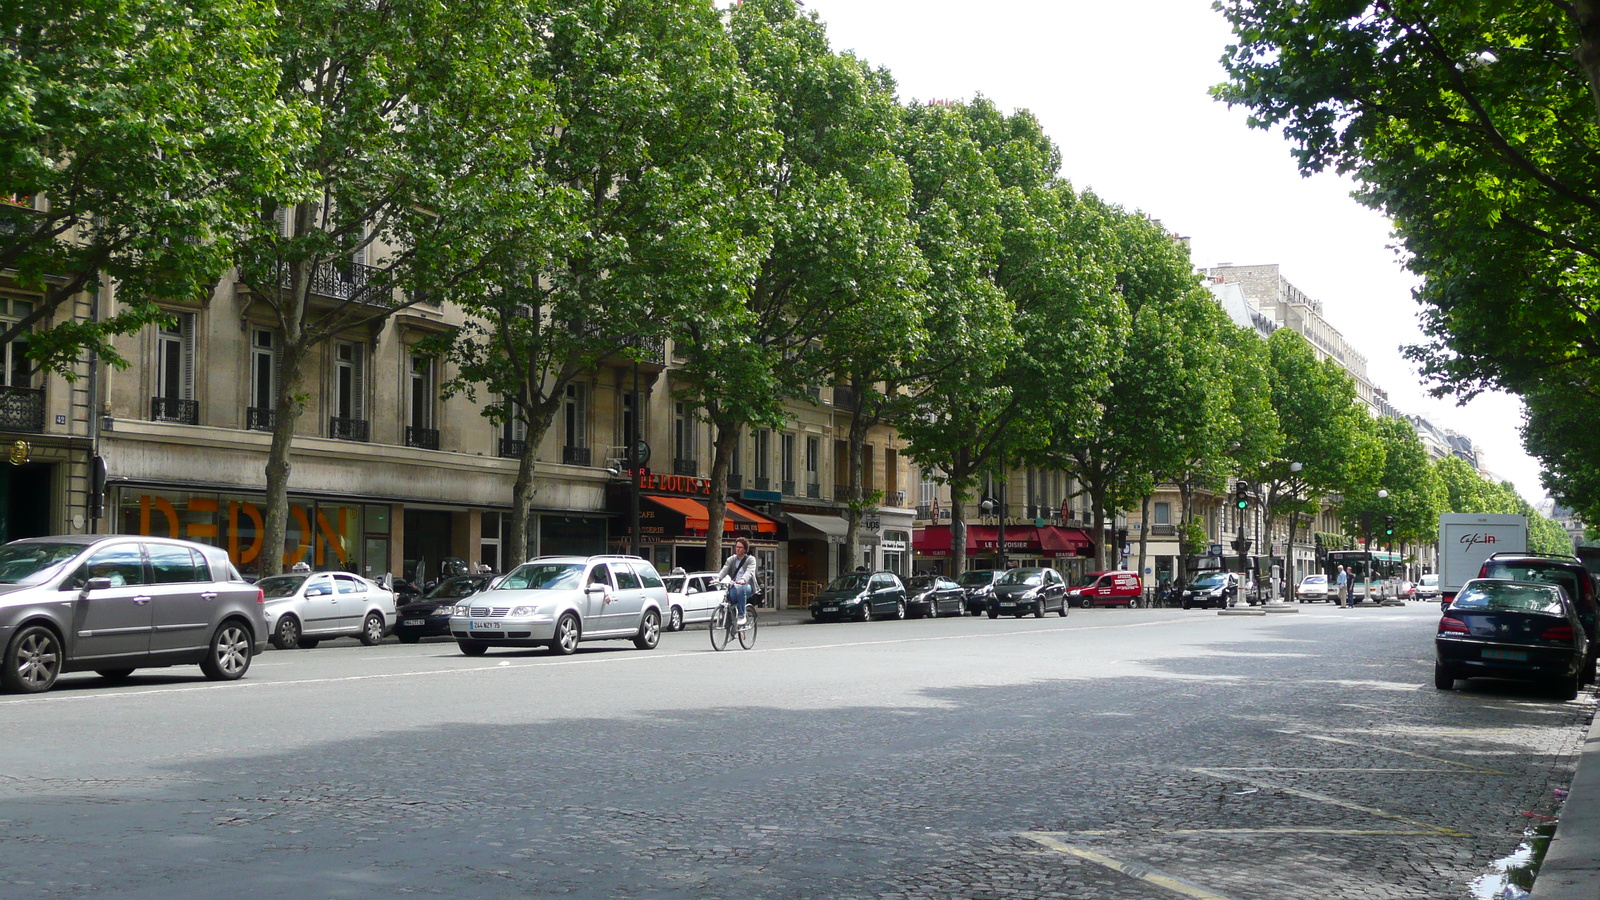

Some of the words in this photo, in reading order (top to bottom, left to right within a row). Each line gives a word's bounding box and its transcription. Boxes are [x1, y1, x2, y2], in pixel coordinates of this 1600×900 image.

[56, 415, 65, 424] 42
[627, 468, 645, 477] BR
[640, 474, 655, 489] LE
[660, 474, 698, 493] LOUIS
[866, 521, 880, 532] ups
